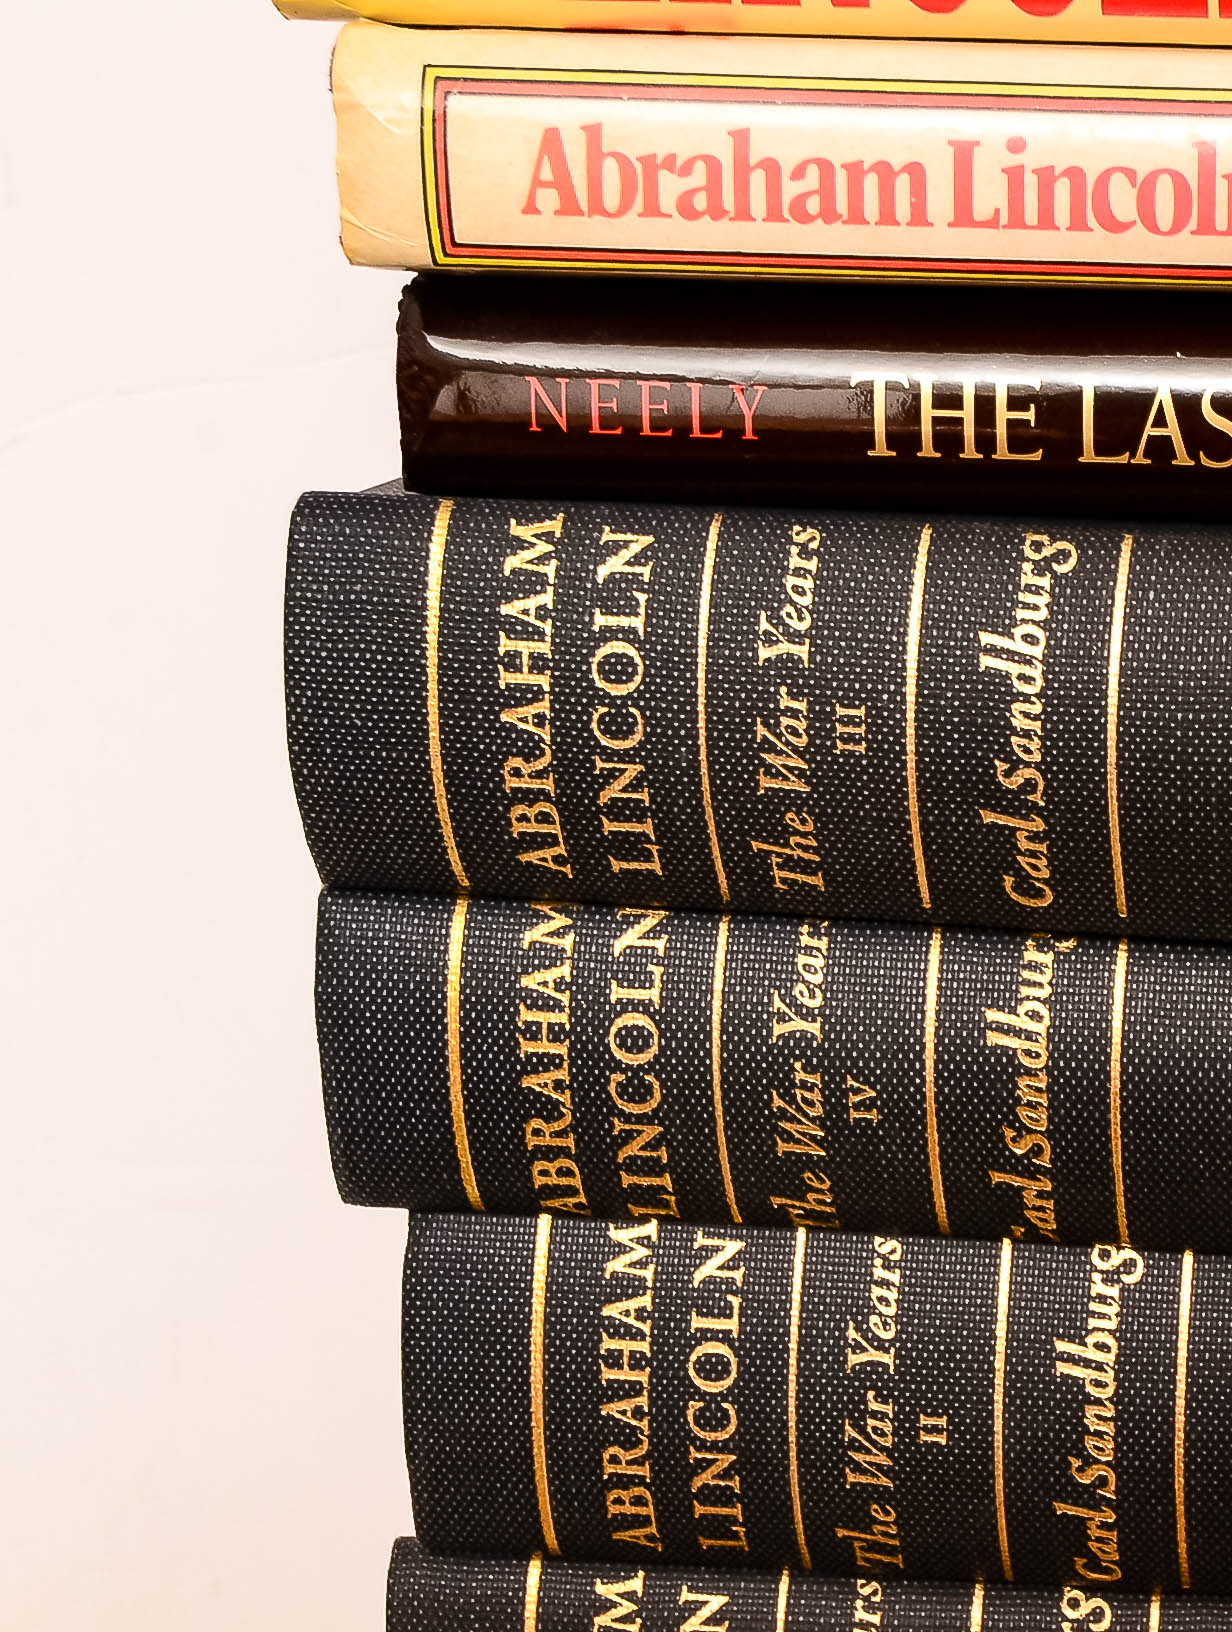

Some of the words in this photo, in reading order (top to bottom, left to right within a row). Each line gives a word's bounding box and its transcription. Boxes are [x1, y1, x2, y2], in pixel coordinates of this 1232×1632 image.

[521, 123, 934, 228] Abraham
[525, 376, 768, 440] NEELY
[850, 370, 1043, 461] THE
[757, 524, 822, 668] Years
[498, 513, 573, 879] ABRAHAM
[591, 525, 662, 876] LINCOLN
[978, 531, 1078, 806] Sandburg
[756, 685, 811, 796] War
[836, 702, 866, 755] III
[751, 810, 825, 892] The
[979, 808, 1053, 908] Carl
[608, 907, 681, 1218] LINCOLN
[847, 1074, 878, 1126] IV
[984, 932, 1077, 1168] Sandbur
[772, 1061, 827, 1156] War
[988, 1170, 1060, 1240] arl
[845, 1235, 903, 1375] Years
[600, 1218, 661, 1553] ABRAHAM
[686, 1230, 749, 1552] LINCOLN
[1053, 1242, 1146, 1500] Sandburg
[844, 1390, 894, 1489] War
[919, 1413, 948, 1446] II
[834, 1503, 905, 1569] The
[1052, 1502, 1122, 1582] Carl
